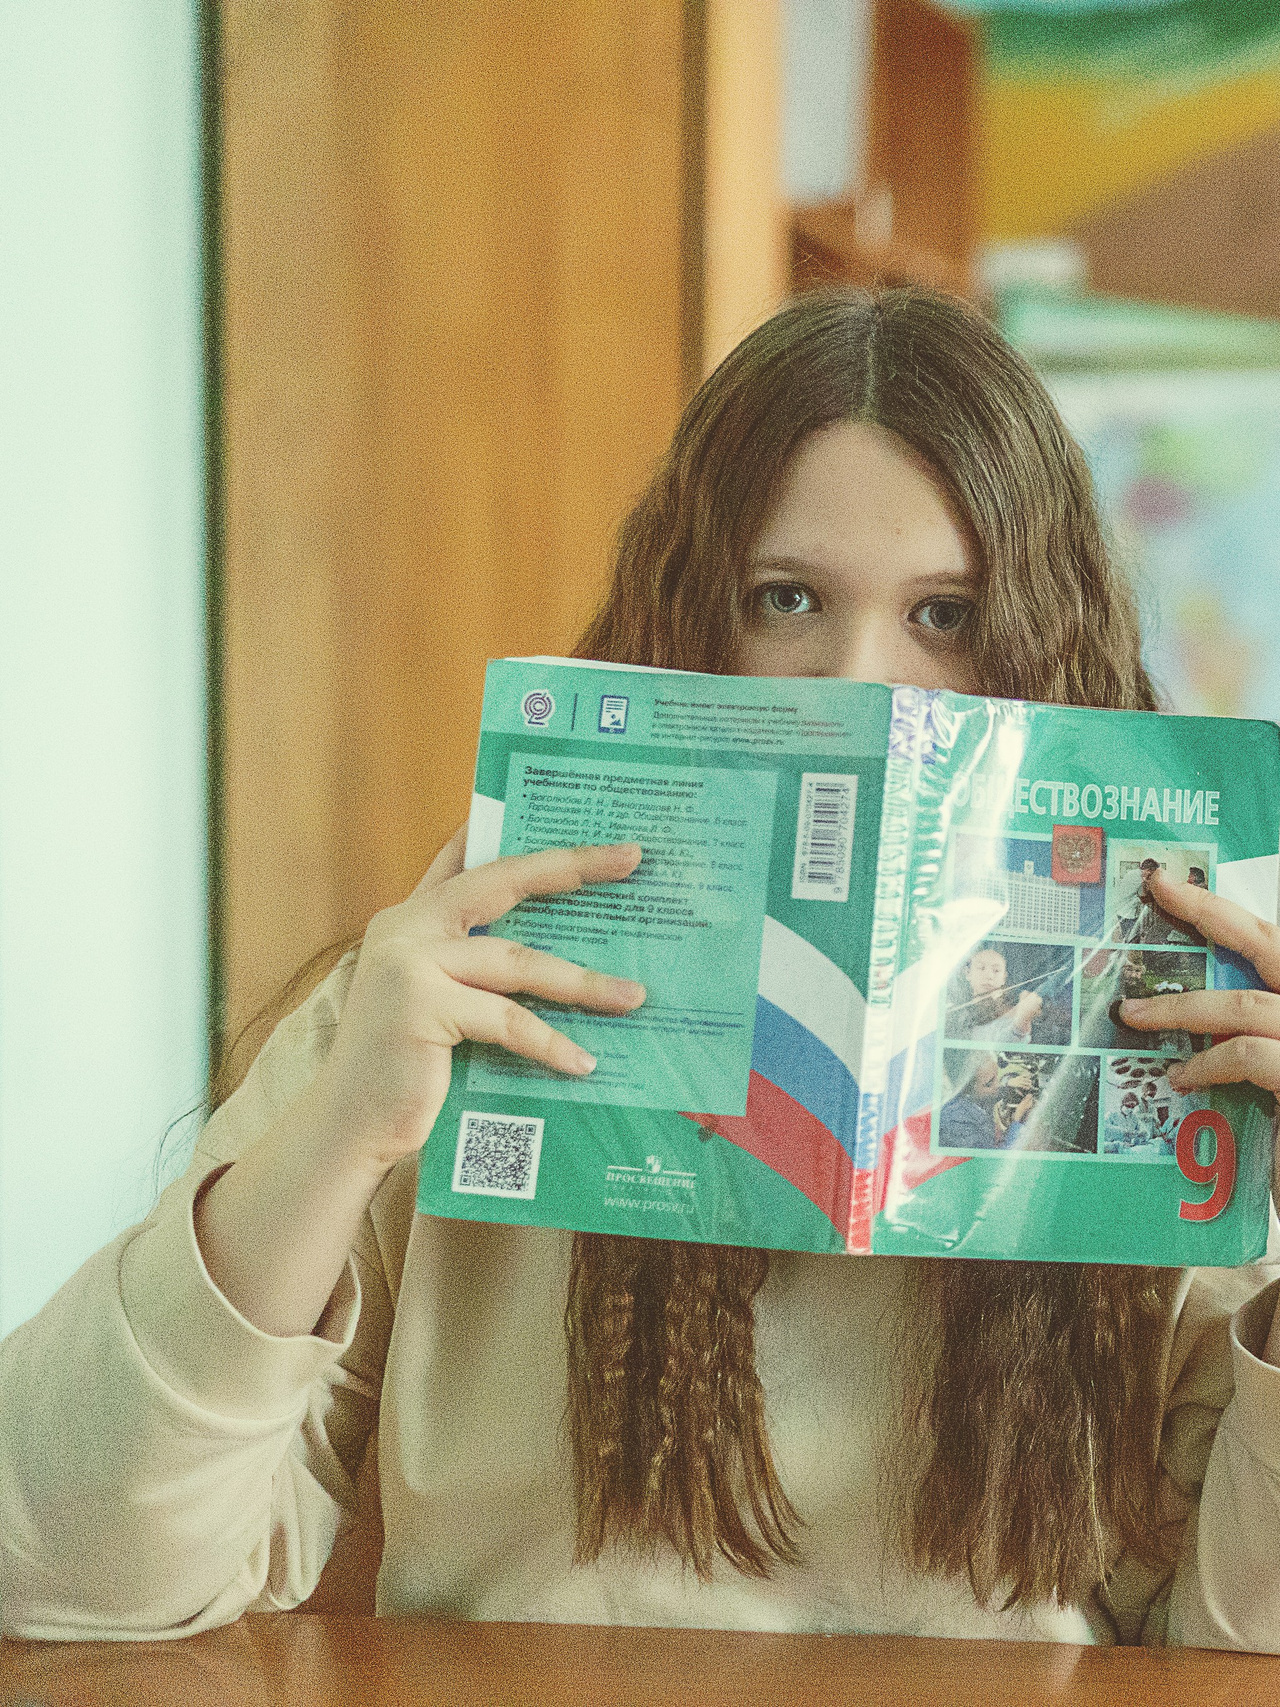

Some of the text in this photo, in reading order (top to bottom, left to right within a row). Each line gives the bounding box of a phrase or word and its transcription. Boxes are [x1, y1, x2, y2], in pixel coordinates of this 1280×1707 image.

[523, 777, 580, 791] учебников
[583, 782, 597, 792] по
[524, 765, 601, 781] Завершённая
[603, 773, 669, 787] предметная
[1175, 1108, 1237, 1223] 9
